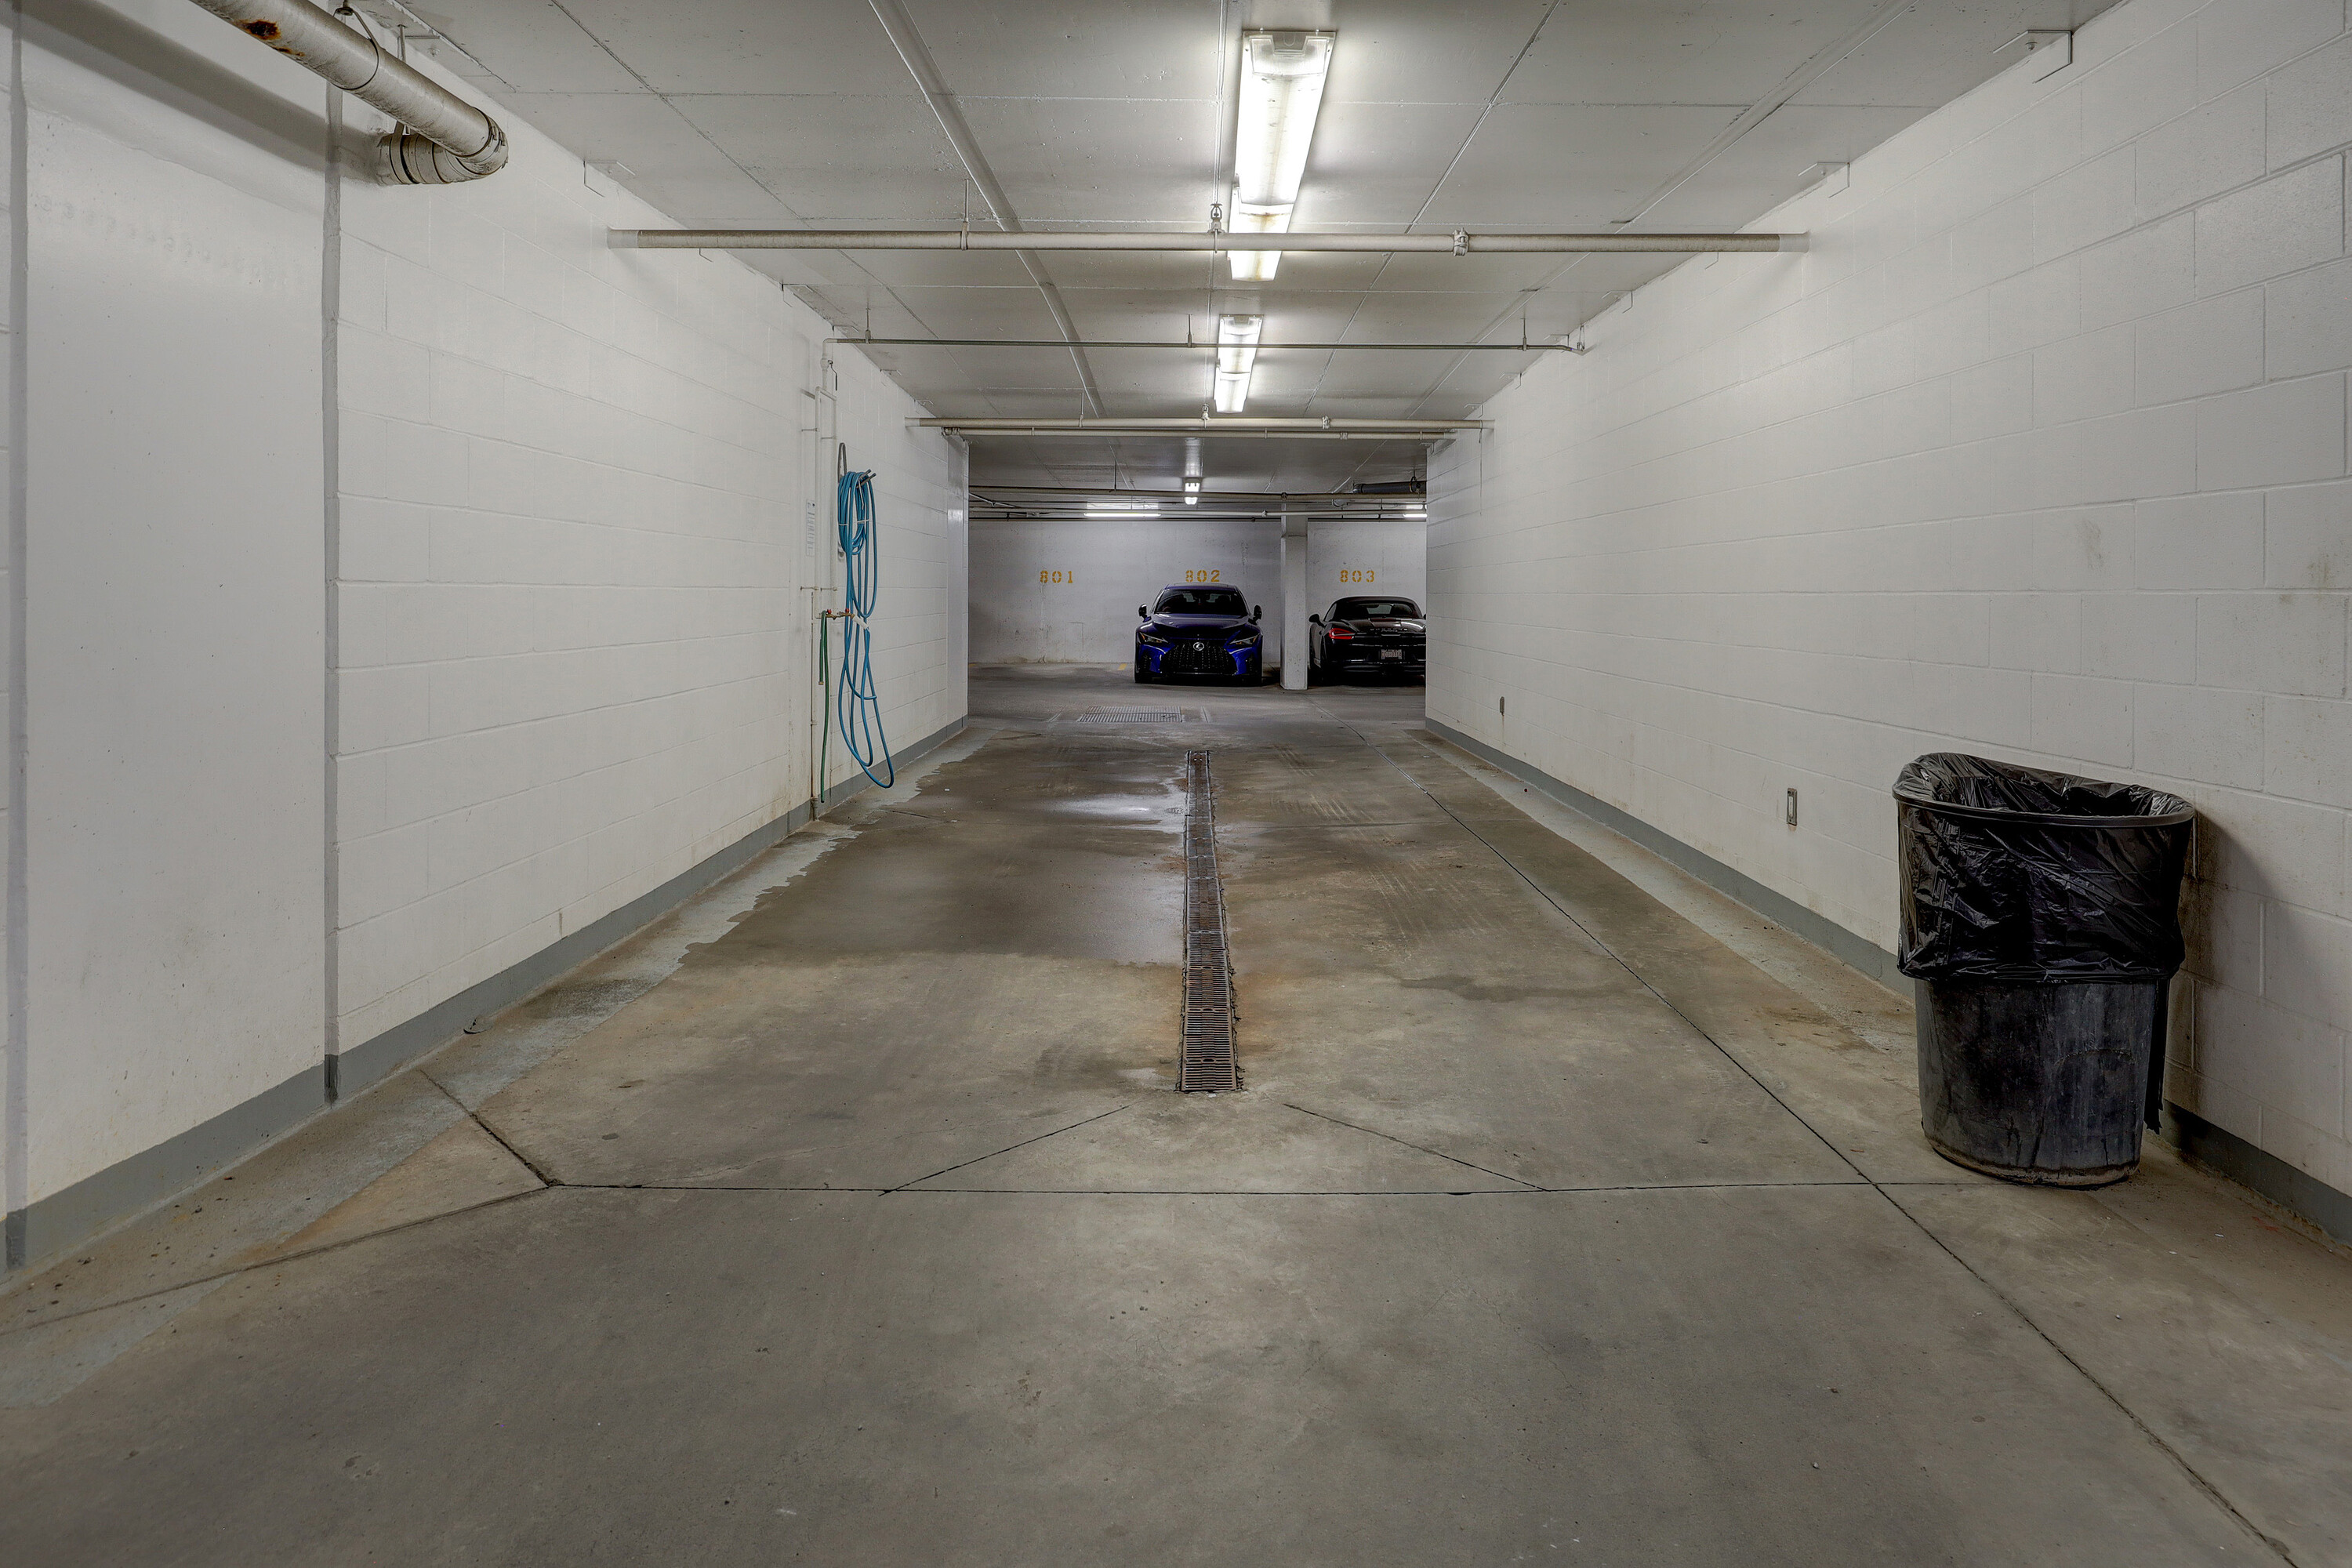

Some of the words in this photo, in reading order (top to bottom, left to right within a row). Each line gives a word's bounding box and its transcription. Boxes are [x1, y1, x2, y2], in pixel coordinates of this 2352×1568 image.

[1040, 570, 1073, 584] 801
[1185, 569, 1221, 583] 802
[1340, 569, 1375, 583] 803
